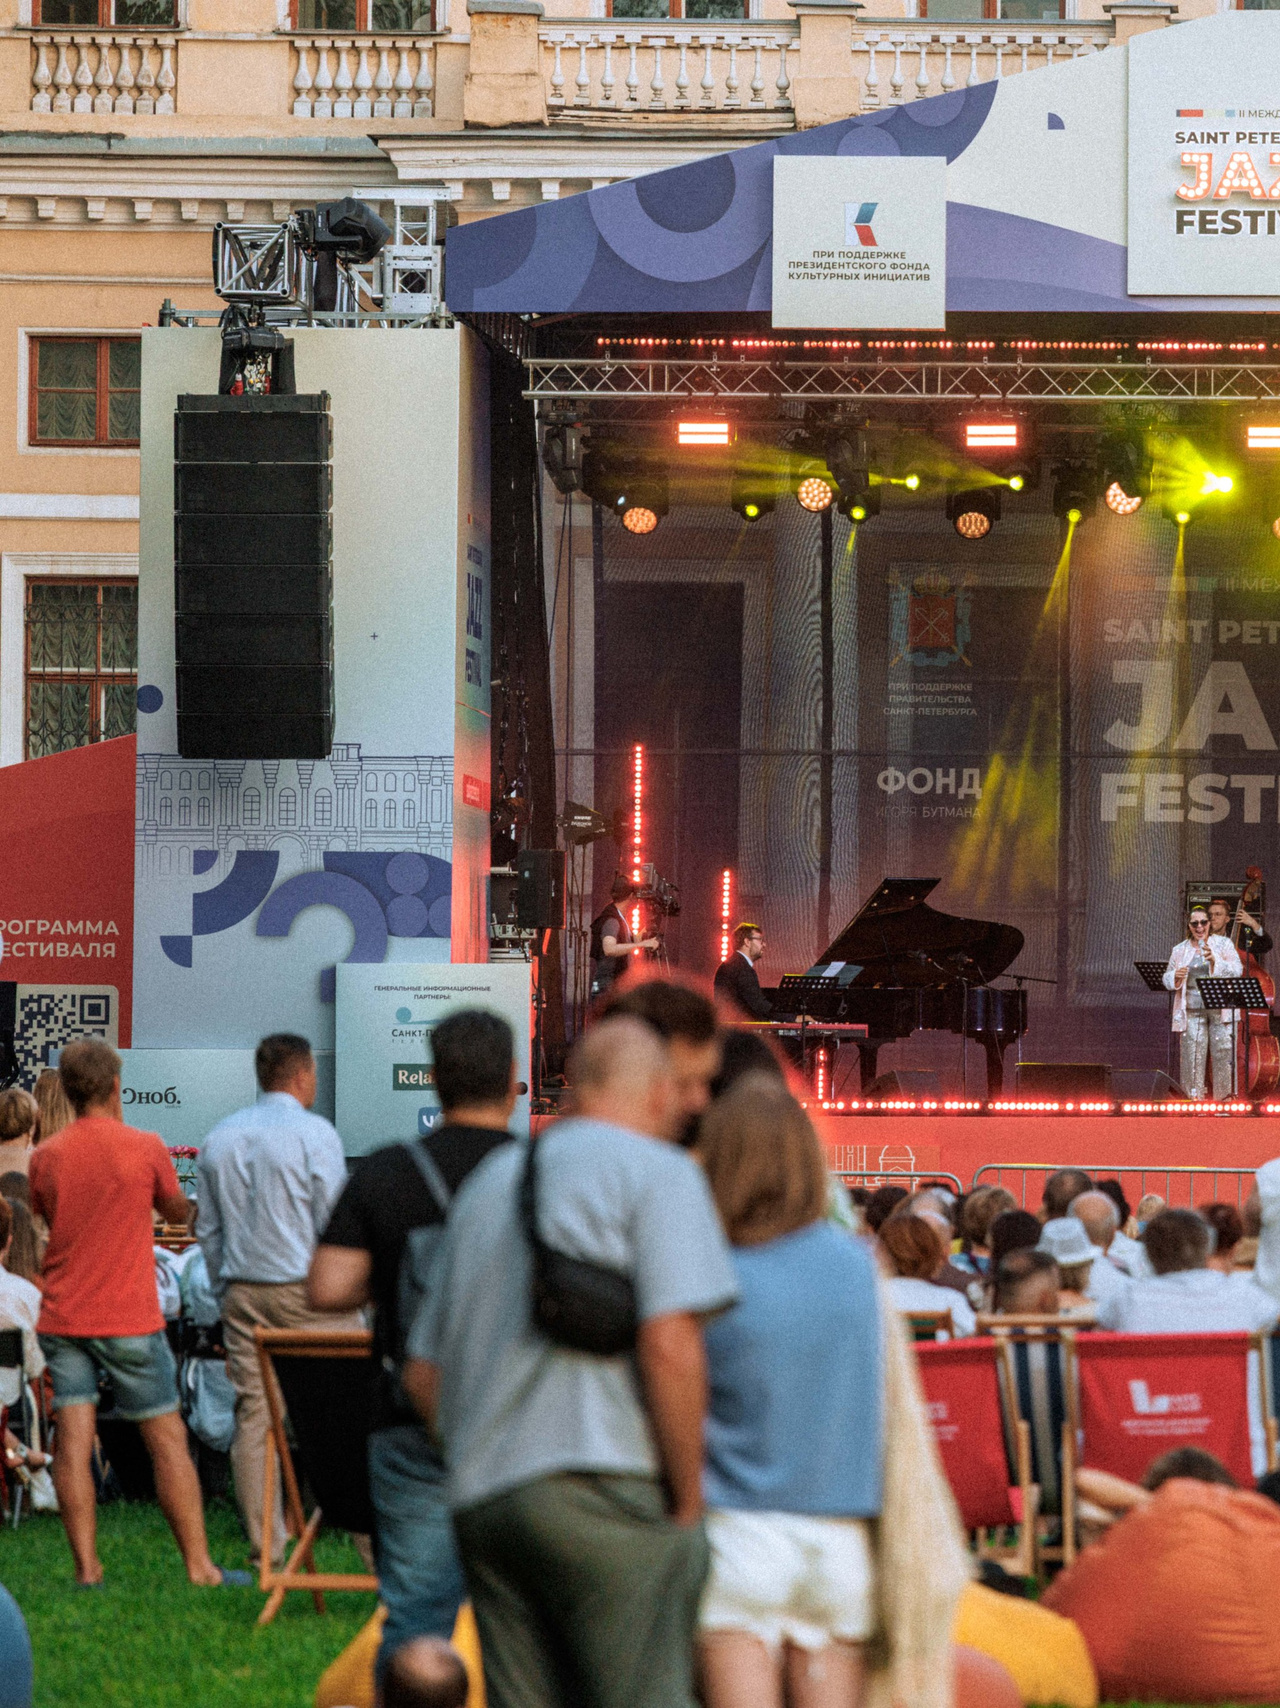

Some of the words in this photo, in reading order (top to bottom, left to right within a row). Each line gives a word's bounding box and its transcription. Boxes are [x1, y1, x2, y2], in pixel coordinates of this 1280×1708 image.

[1175, 131, 1230, 144] SAINT
[812, 251, 835, 259] ПРИ
[838, 251, 907, 260] ПОДДЕРЖКЕ
[788, 261, 887, 271] ПРЕЗИДЕНТСКОГО
[890, 262, 930, 271] ФОНДА
[788, 272, 860, 281] КУЛЬТУРНЫХ
[864, 273, 931, 282] ИНИЦИАТИВ
[1102, 618, 1209, 644] SAINT
[911, 683, 973, 693] ПОДДЕРЖКЕ
[889, 695, 972, 705] ПРАВИТЕЛЬСТВА
[883, 707, 977, 716] САНКТ-ПЕТЕРБУРГА
[876, 766, 983, 800] ФОНД
[922, 806, 981, 818] БУТМАНА
[398, 1069, 434, 1086] Rela
